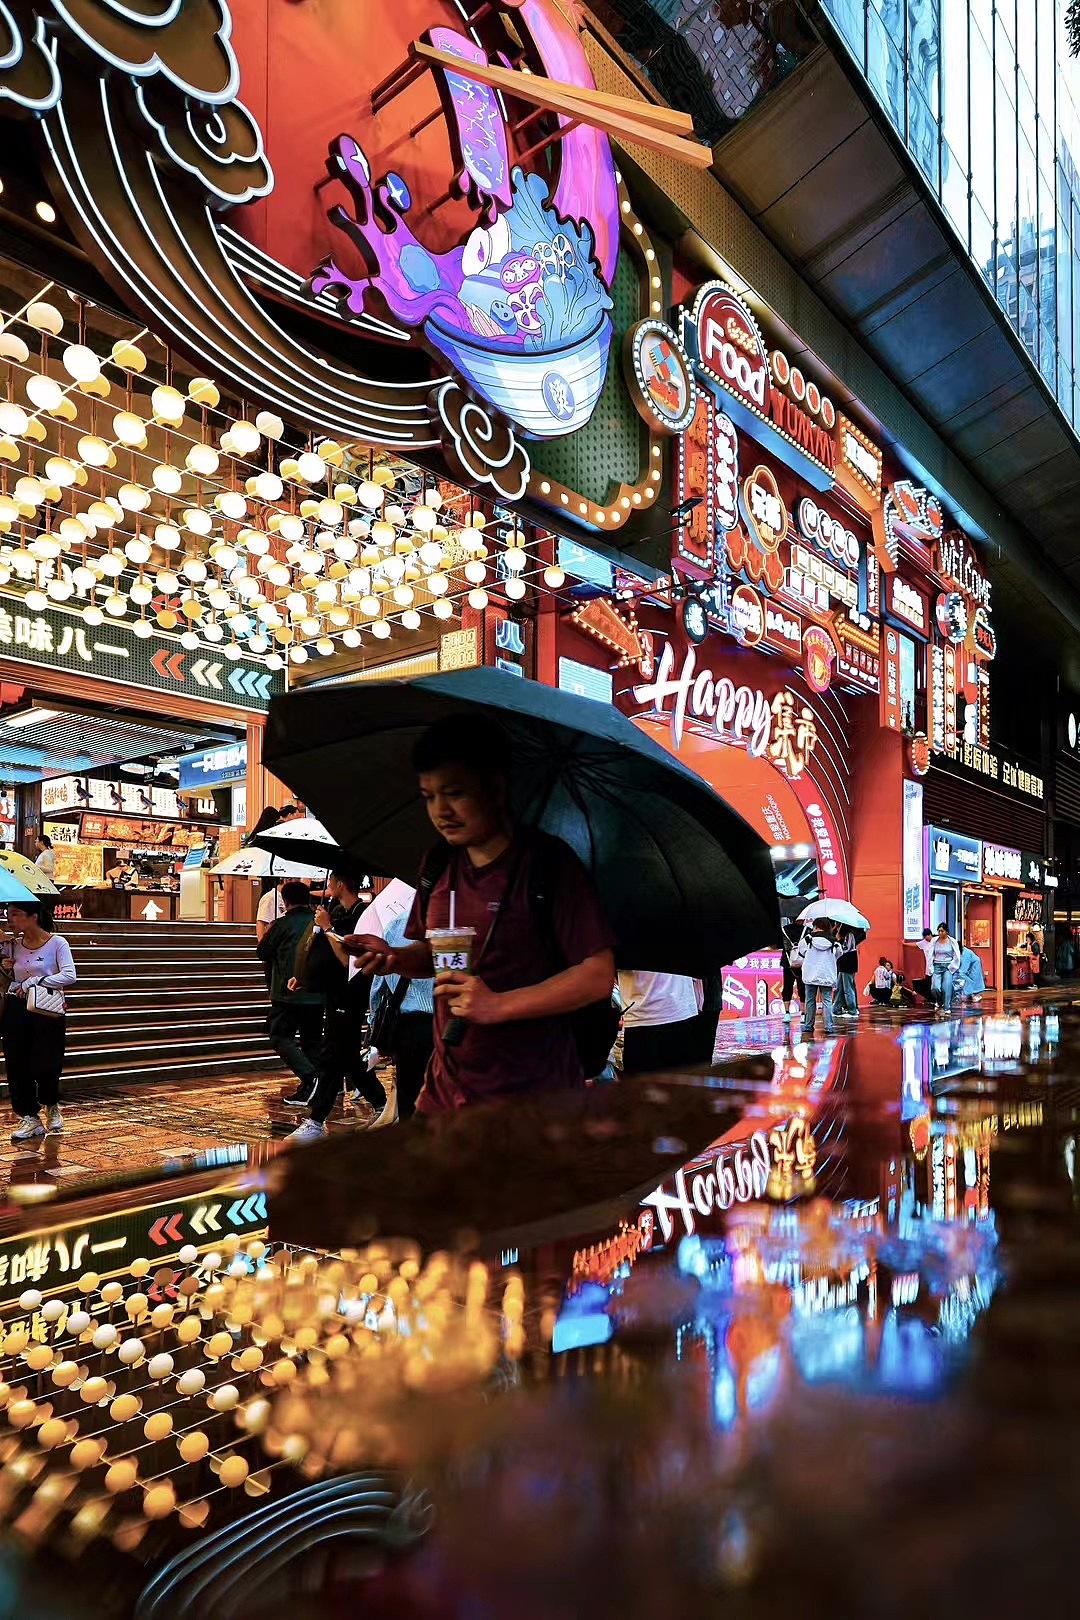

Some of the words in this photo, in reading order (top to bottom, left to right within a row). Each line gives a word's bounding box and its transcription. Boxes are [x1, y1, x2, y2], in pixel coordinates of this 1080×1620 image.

[707, 318, 765, 406] Food
[771, 388, 836, 467] YUMMY
[941, 538, 992, 611] WELCOME
[633, 641, 771, 757] Happy
